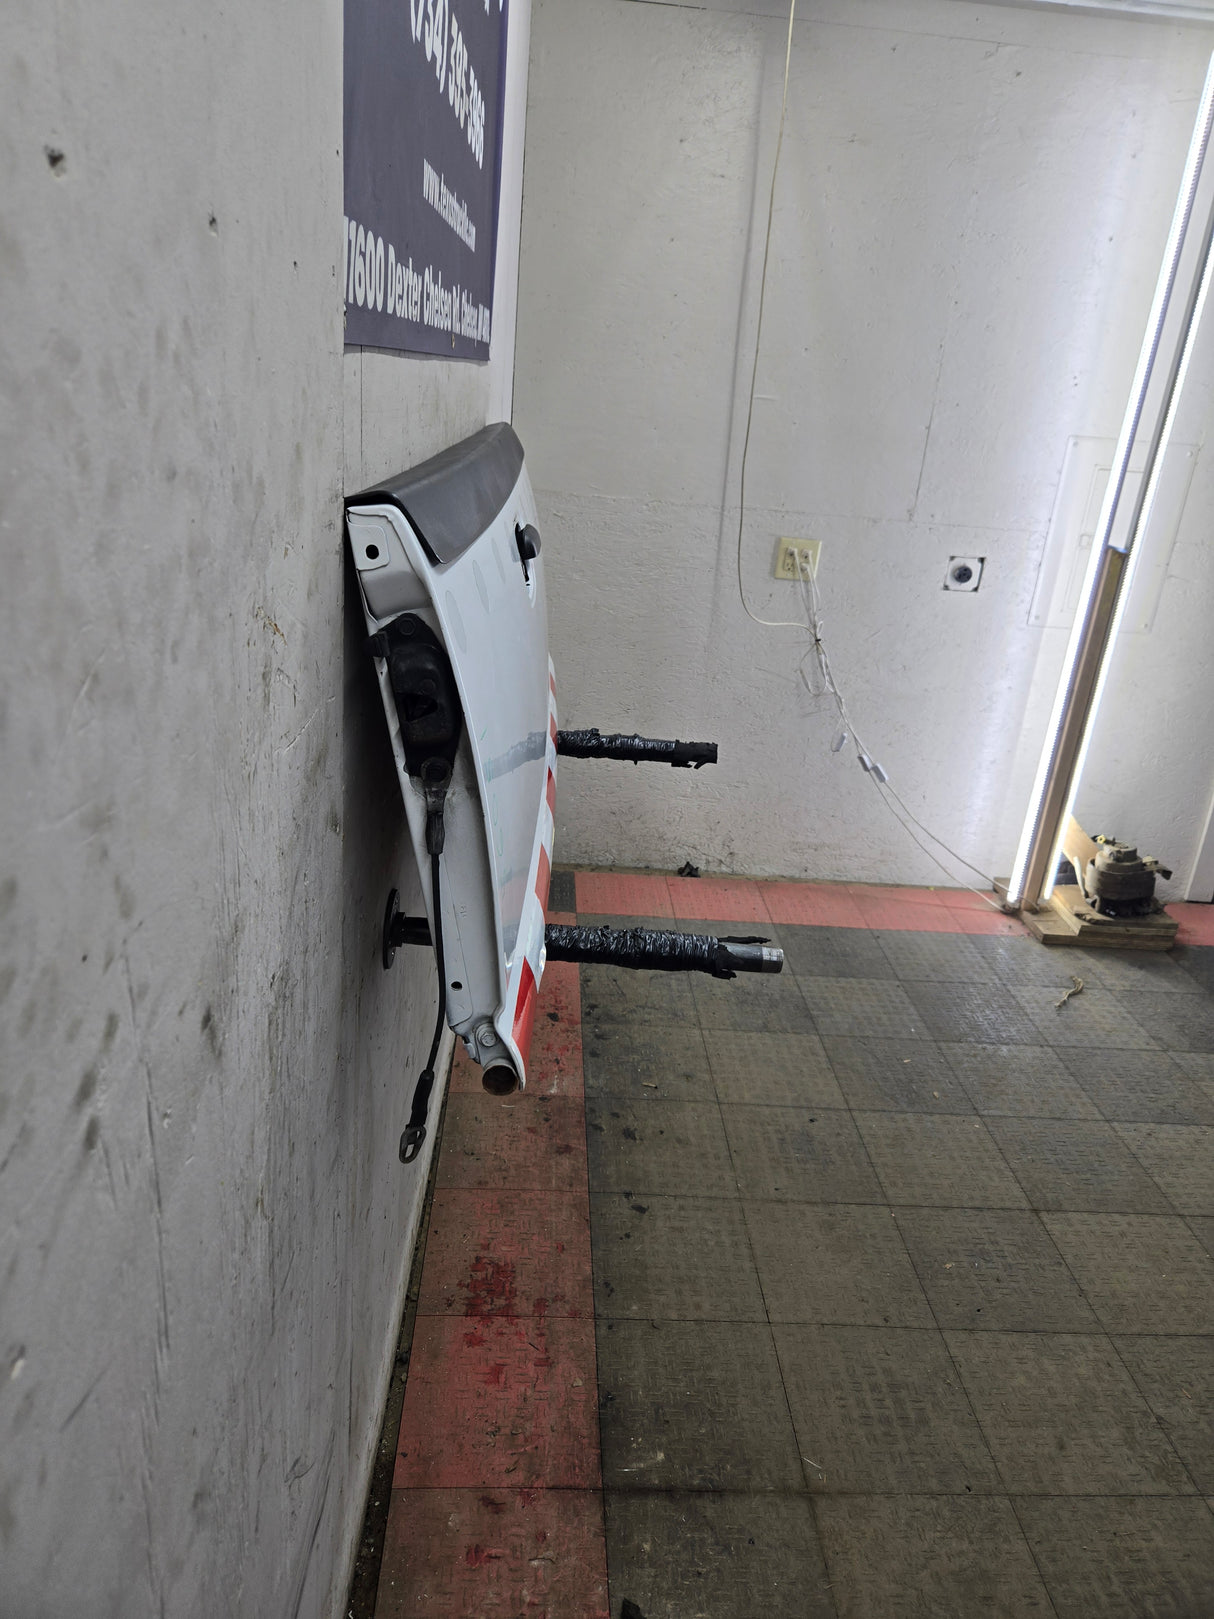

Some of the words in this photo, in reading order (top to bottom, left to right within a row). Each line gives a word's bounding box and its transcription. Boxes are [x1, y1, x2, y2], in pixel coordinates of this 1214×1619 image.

[387, 243, 422, 322] Dexter
[424, 264, 452, 331] Chelsea
[452, 283, 461, 335] Rd.
